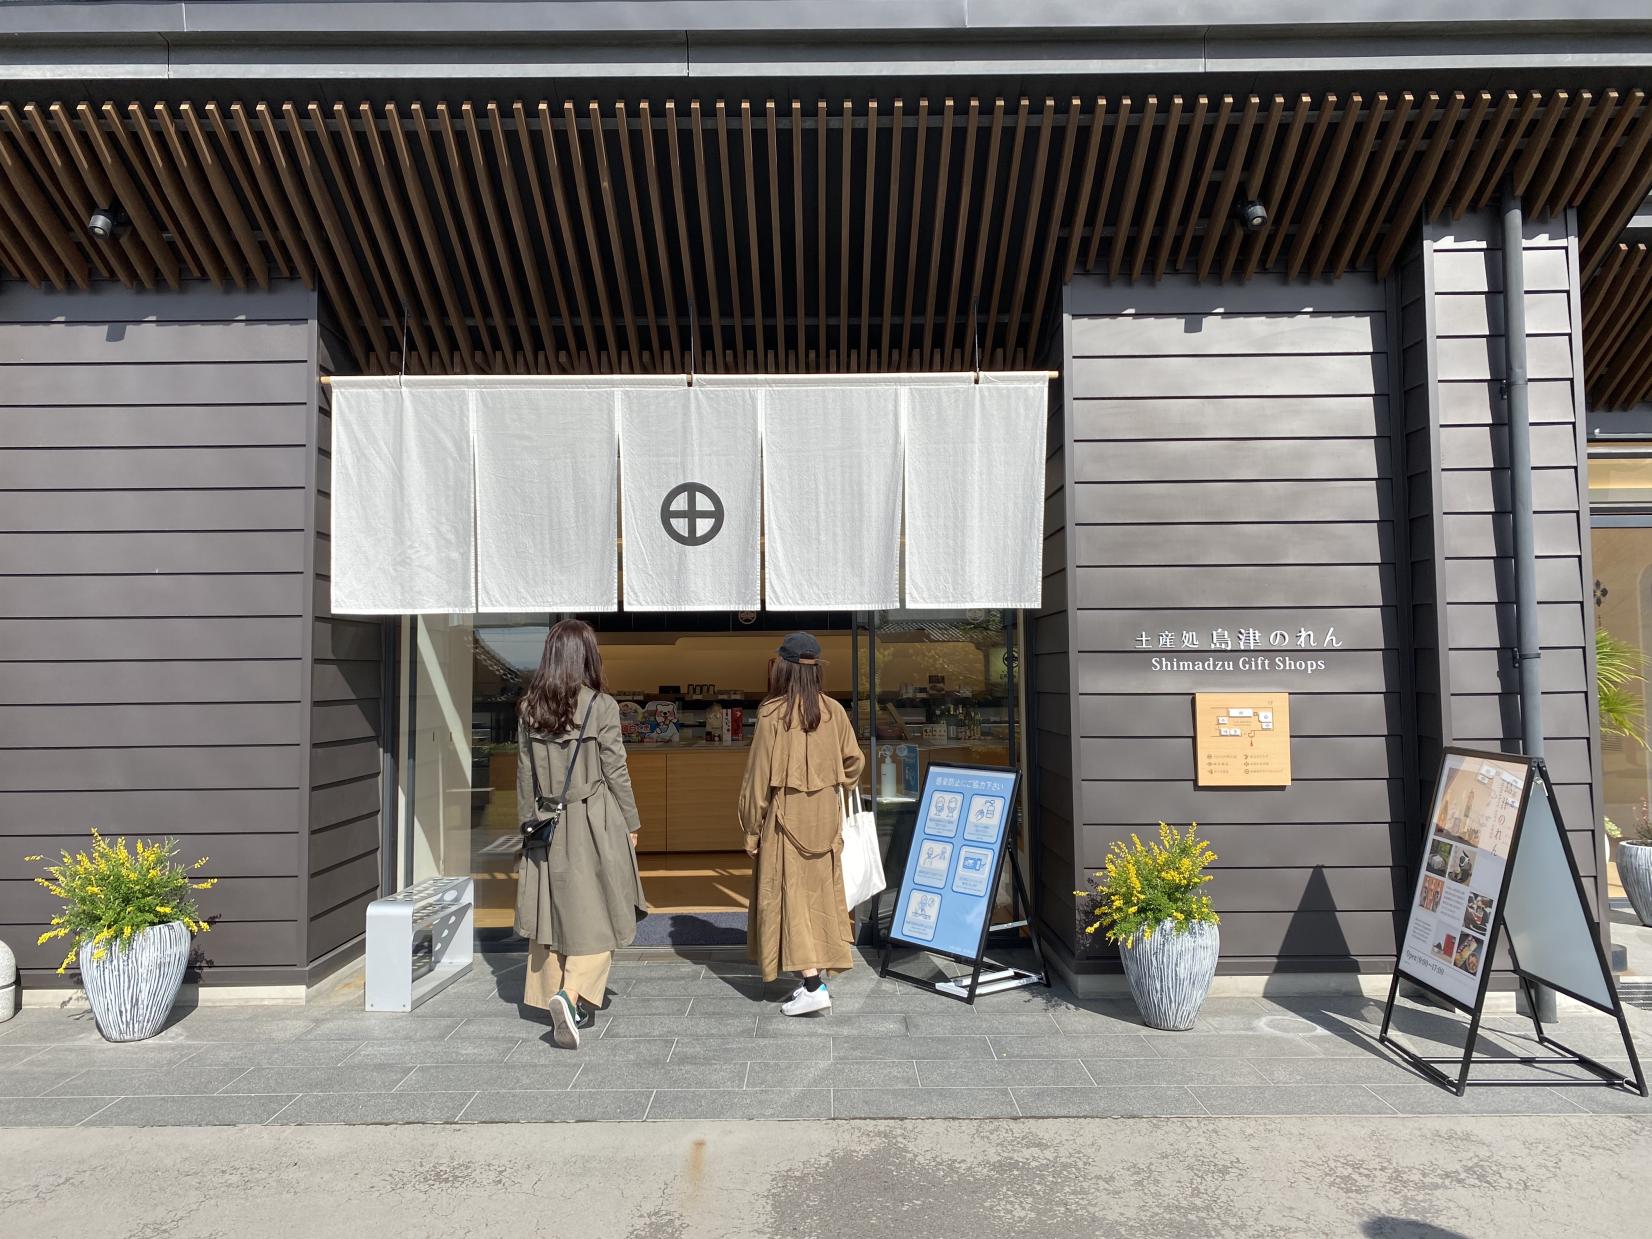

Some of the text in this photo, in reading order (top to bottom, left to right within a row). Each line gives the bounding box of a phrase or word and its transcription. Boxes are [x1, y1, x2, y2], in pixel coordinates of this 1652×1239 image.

[1135, 627, 1343, 650] 土産処 島津のれん
[1151, 657, 1326, 674] Shimadzu Gift Shops
